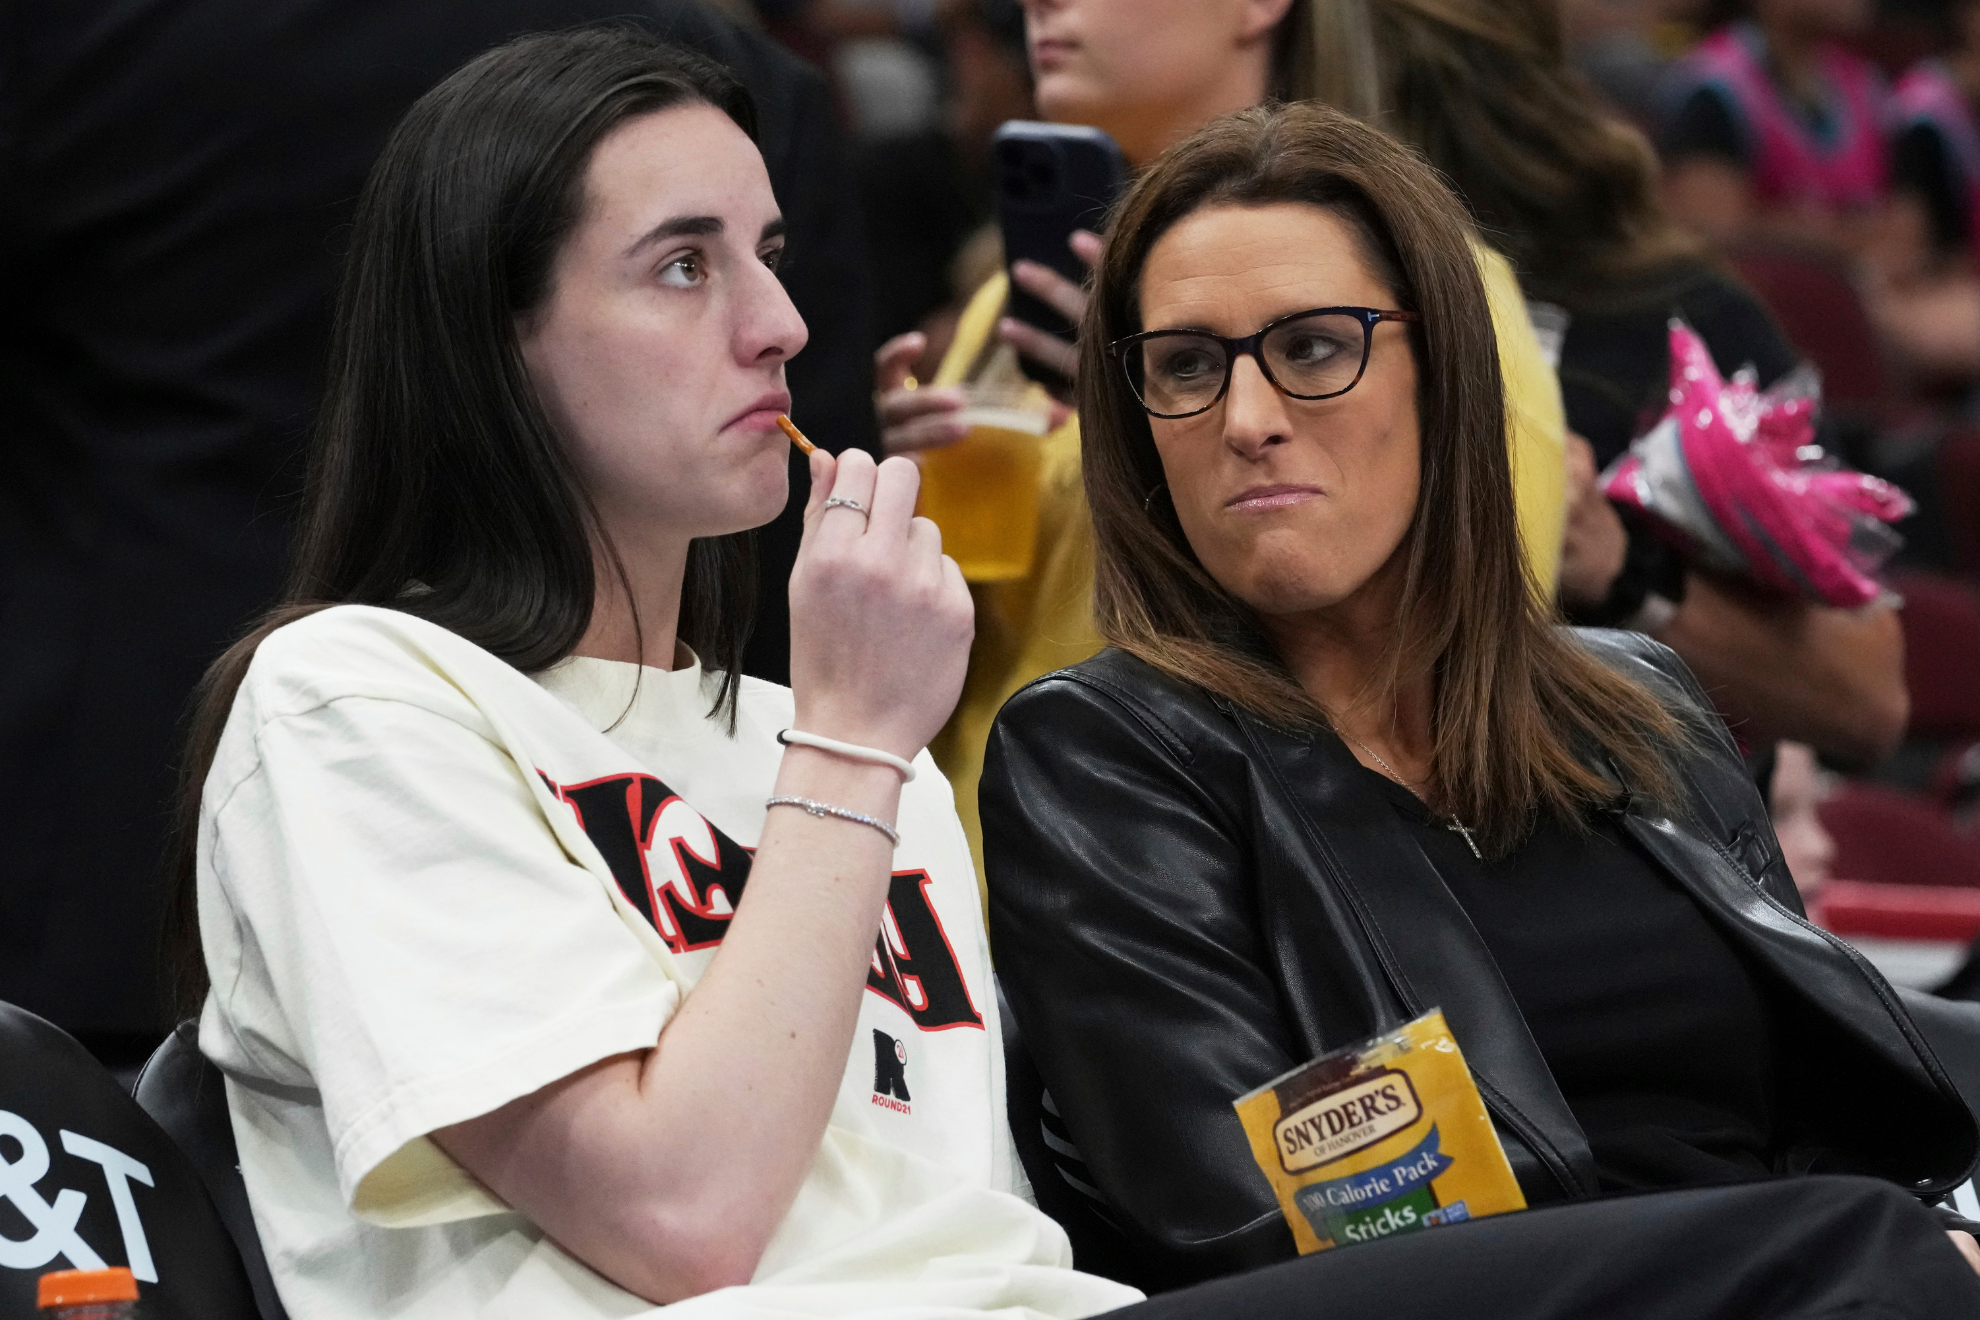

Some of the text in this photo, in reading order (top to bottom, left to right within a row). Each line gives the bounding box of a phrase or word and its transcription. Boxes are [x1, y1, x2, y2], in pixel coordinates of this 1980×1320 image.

[872, 1094, 911, 1115] ROUND21
[1283, 1084, 1404, 1155] SNYDER'S
[1314, 1125, 1376, 1157] OF HANOVER
[1326, 1177, 1391, 1206] Calorie
[1392, 1151, 1439, 1186] Pack
[1345, 1205, 1417, 1242] Sticks
